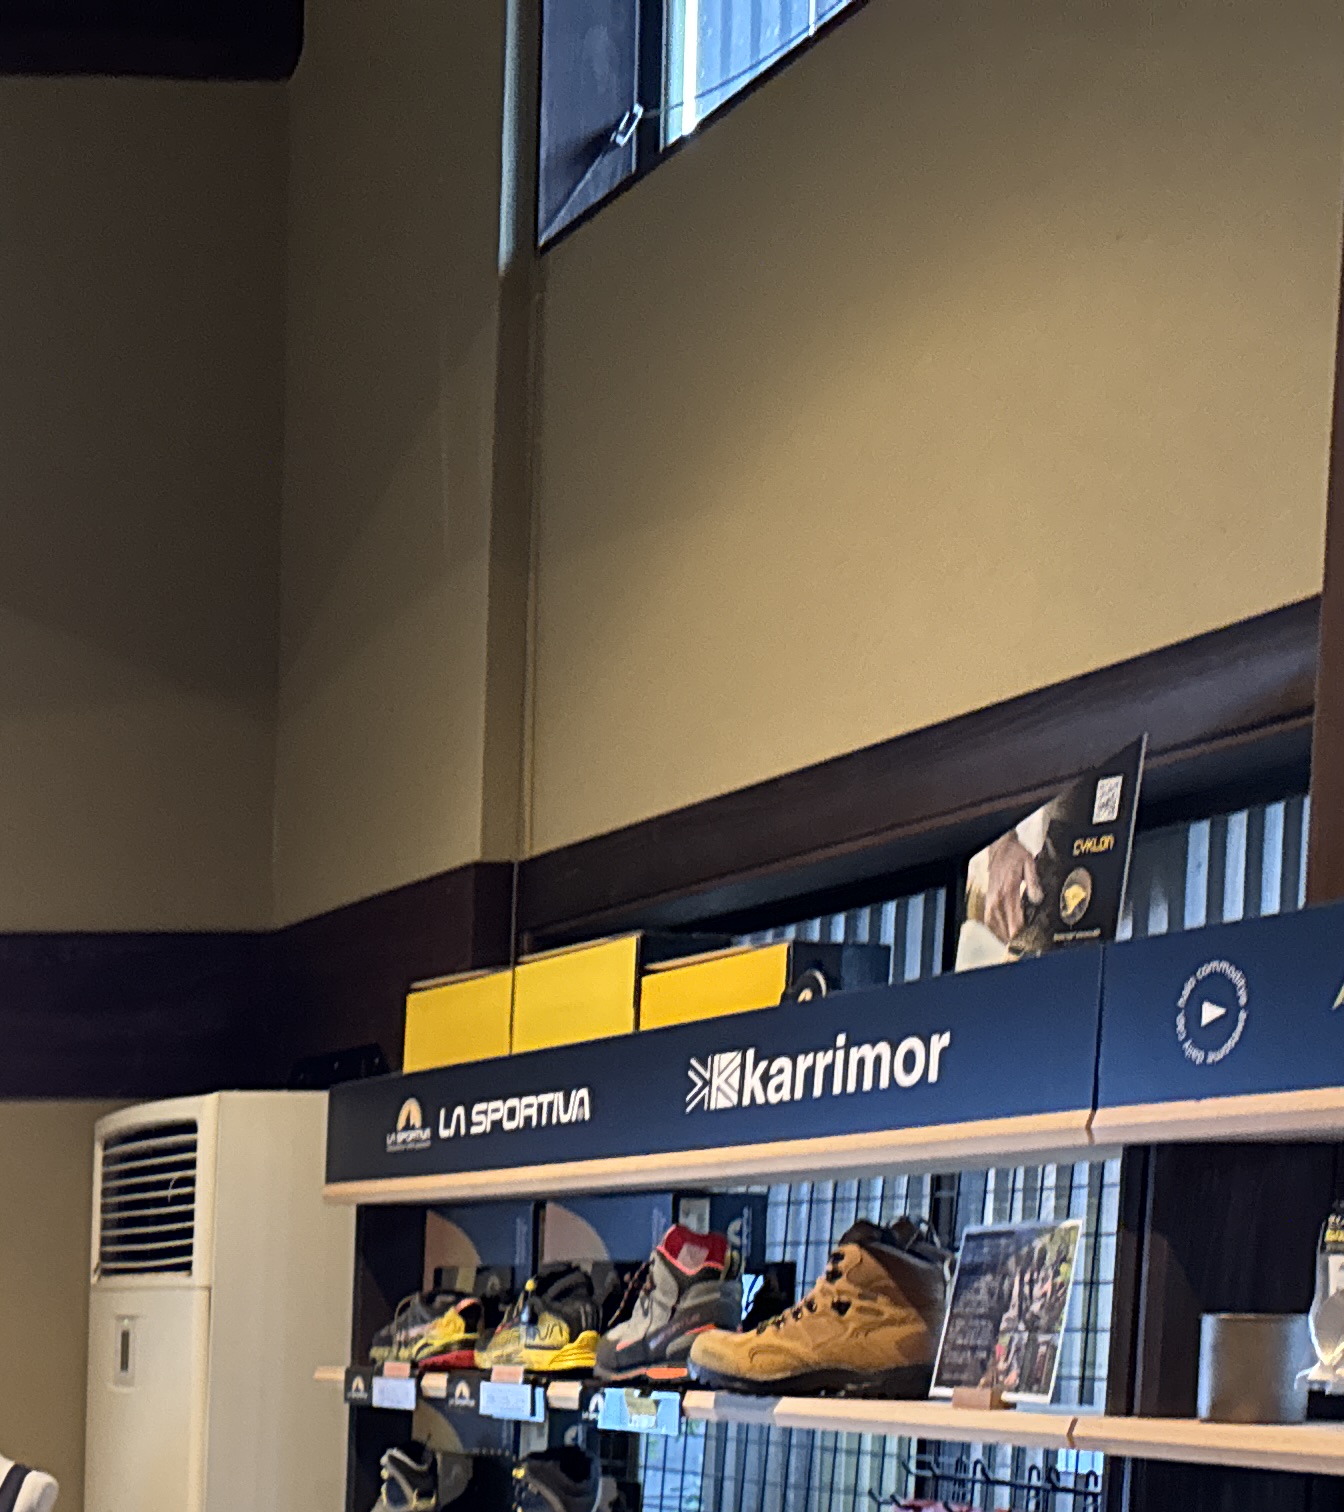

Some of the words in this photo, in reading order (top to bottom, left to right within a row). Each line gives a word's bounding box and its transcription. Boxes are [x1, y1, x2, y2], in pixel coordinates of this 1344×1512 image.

[742, 1031, 951, 1107] karrimor
[439, 1104, 466, 1139] LA
[469, 1087, 591, 1136] SPORTIVA
